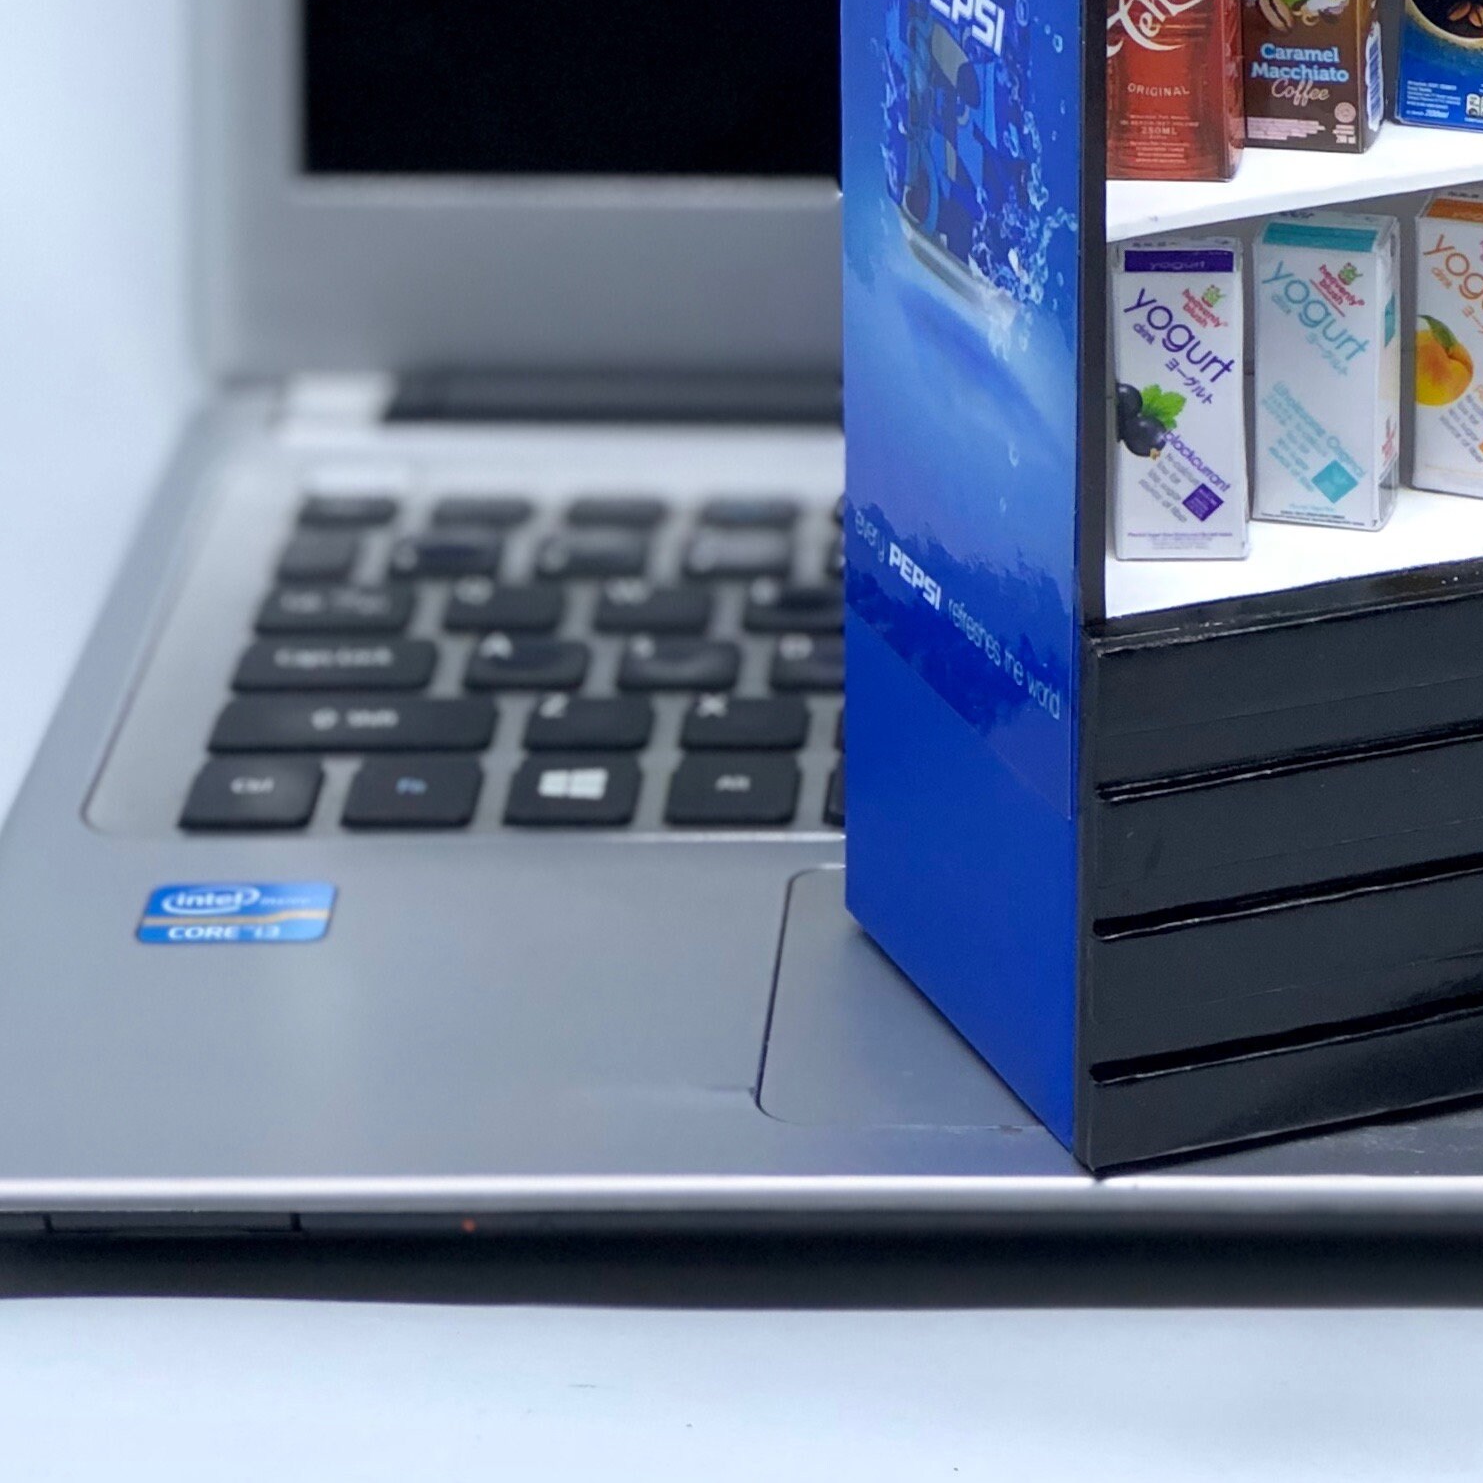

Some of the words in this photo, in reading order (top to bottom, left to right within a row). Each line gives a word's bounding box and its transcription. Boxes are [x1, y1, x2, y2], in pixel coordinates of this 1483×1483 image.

[1260, 42, 1340, 63] Caramel
[1251, 61, 1350, 83] Macchiato
[1127, 82, 1190, 97] ORIGINAL
[1271, 78, 1330, 106] Coffee
[1261, 259, 1370, 362] yogurt
[1123, 287, 1235, 384] yogurt
[889, 540, 943, 612] PEPSI
[168, 925, 240, 941] CORE
